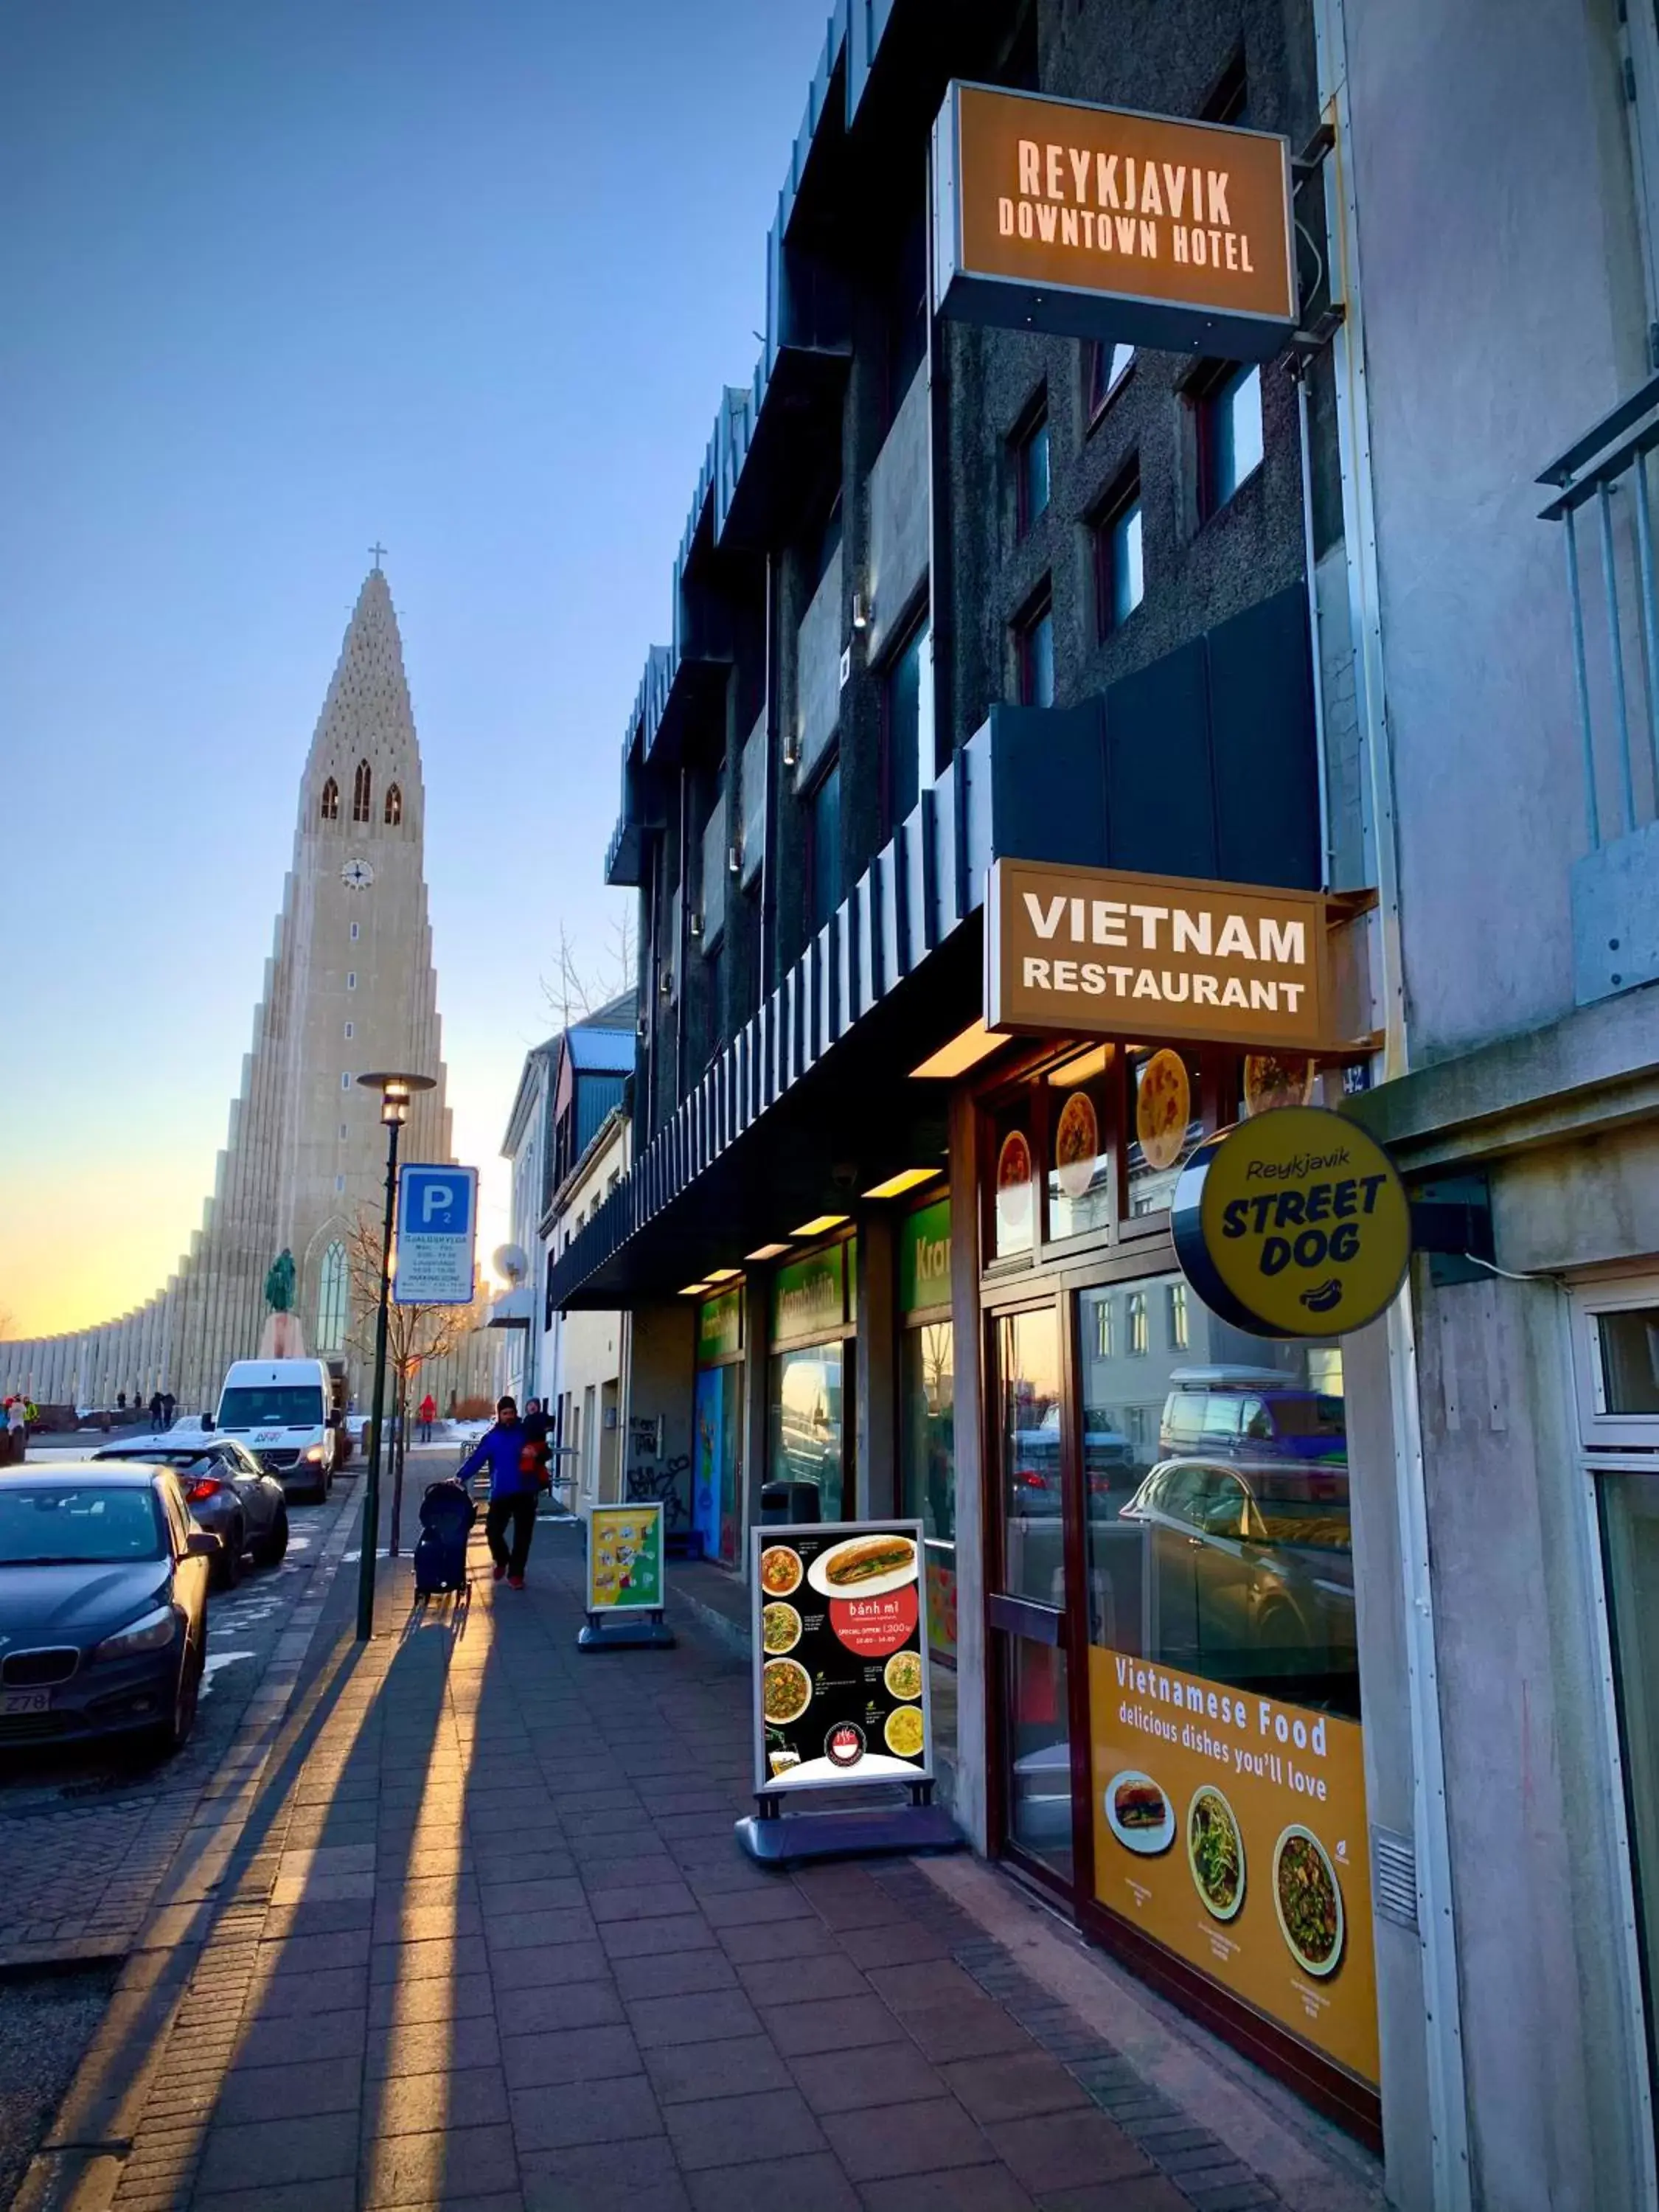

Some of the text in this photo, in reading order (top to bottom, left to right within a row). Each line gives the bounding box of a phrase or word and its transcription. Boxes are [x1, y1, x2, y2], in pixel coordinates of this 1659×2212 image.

[1018, 139, 1231, 226] REYKJAVIK
[998, 197, 1253, 272] DOWNTOWN HOTEL
[1022, 892, 1306, 964] VIETNAM
[1023, 956, 1304, 1012] RESTAURANT
[1246, 1146, 1350, 1180] Reykjavik
[1222, 1174, 1387, 1238] STREET
[1259, 1222, 1360, 1276] DOG
[849, 1601, 880, 1616] bánh
[1115, 1657, 1326, 1756] Vietnamese Food
[1119, 1701, 1326, 1801] delicious dishes you'll love
